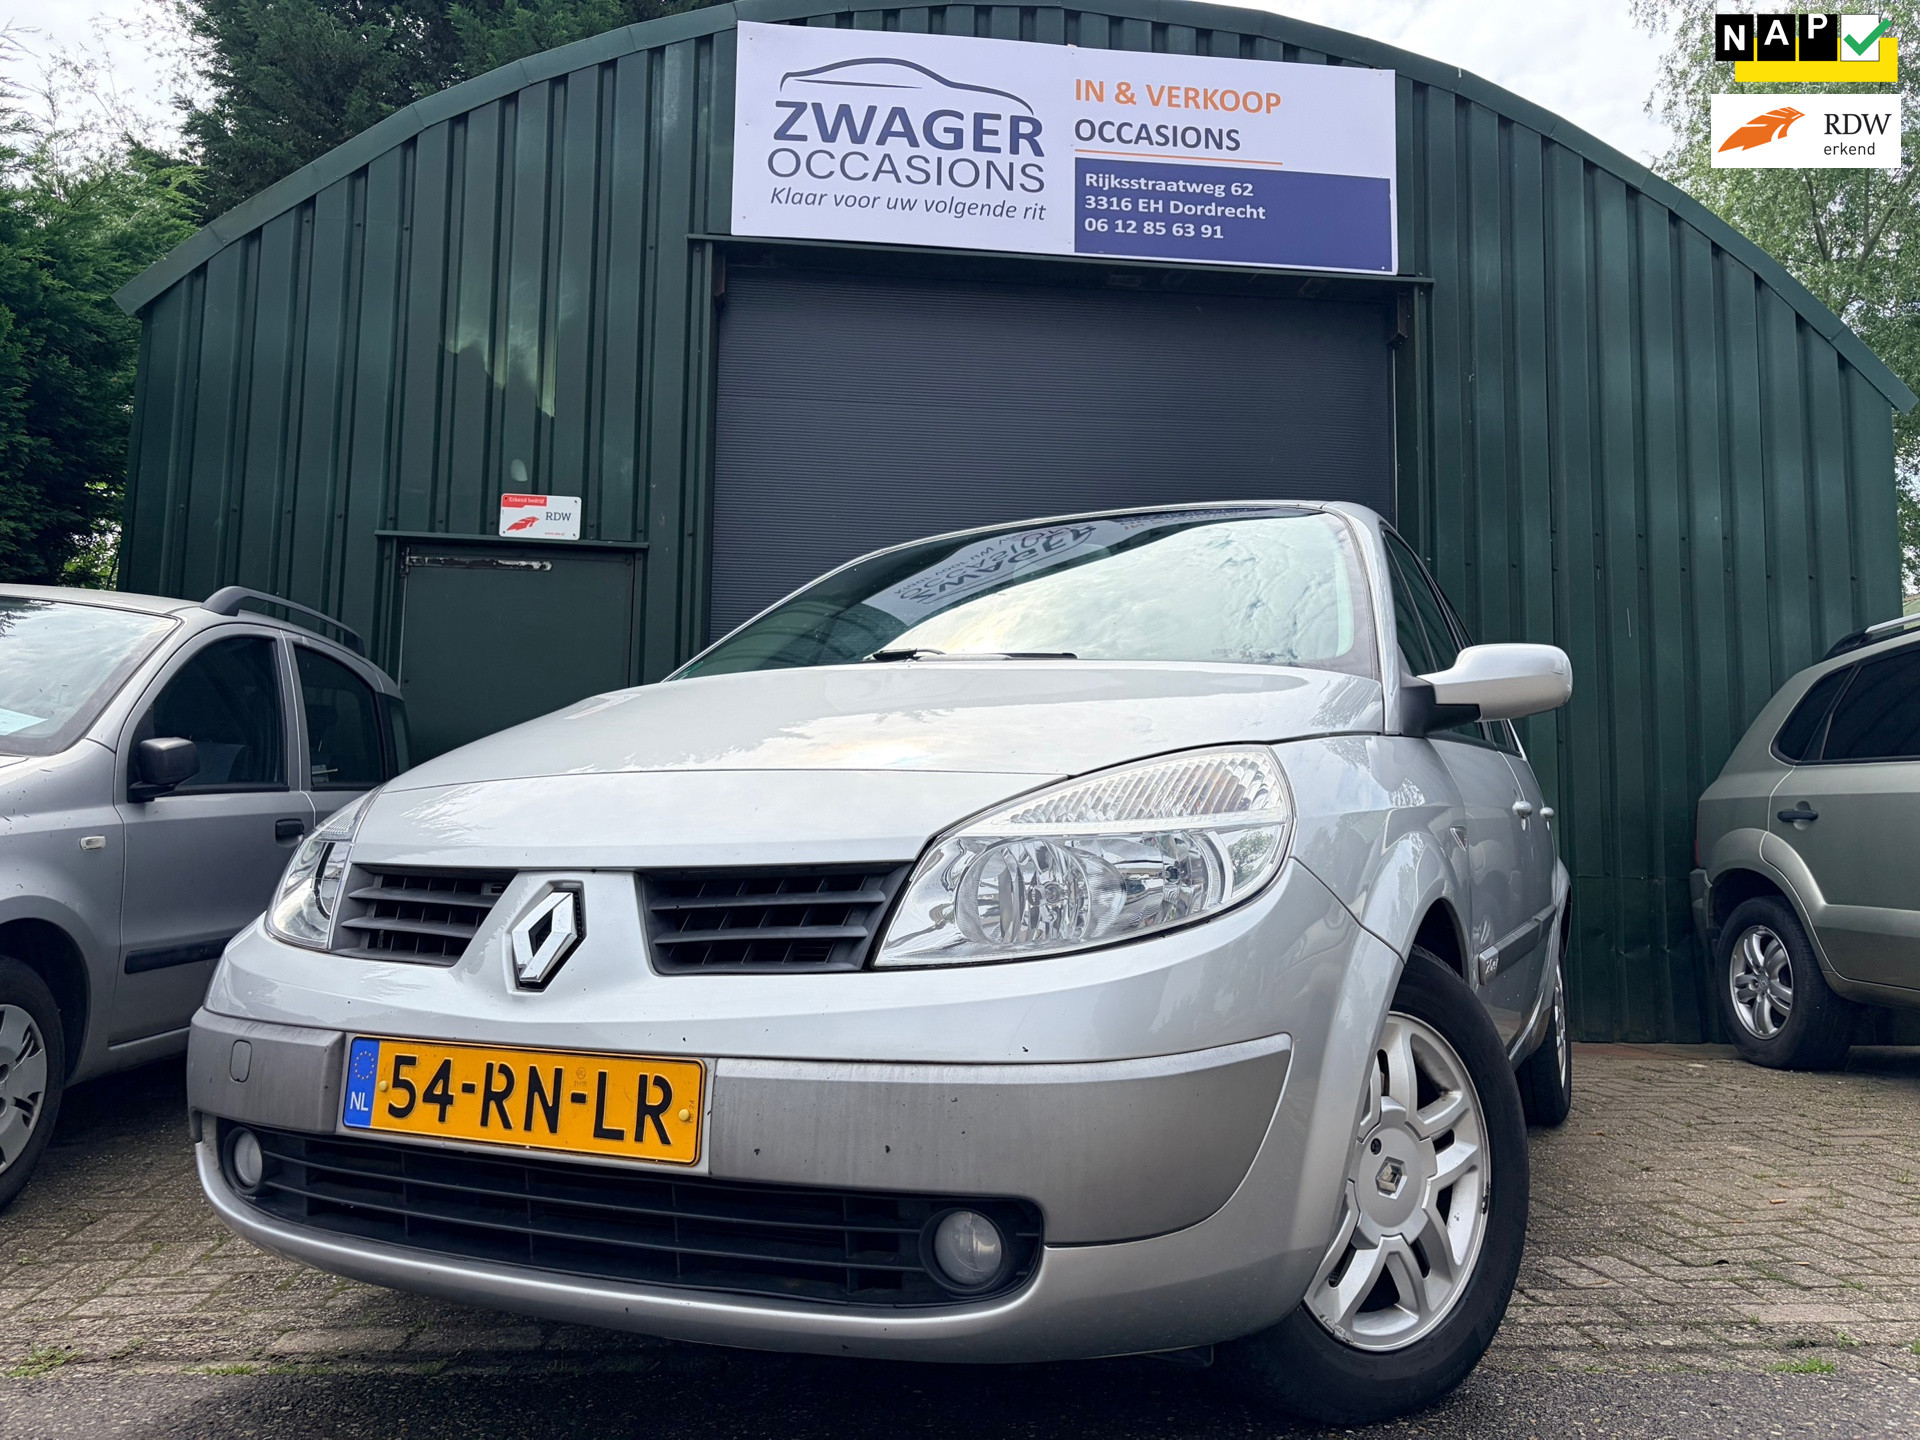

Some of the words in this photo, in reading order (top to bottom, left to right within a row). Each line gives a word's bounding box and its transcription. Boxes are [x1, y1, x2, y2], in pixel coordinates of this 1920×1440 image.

[1075, 79, 1104, 103] IN
[1114, 81, 1136, 105] &
[1146, 84, 1281, 114] VERKOOP
[773, 100, 1045, 157] ZWAGER
[1074, 118, 1241, 151] OCCASIONS
[767, 148, 1045, 193] OCCASIONS
[1085, 173, 1225, 197] Rijksstraatweg
[1231, 182, 1254, 196] 62
[770, 187, 827, 206] Klaar
[833, 193, 881, 209] voor
[886, 196, 918, 211] uw
[924, 197, 1017, 219] volgende
[1023, 203, 1047, 221] rit
[1085, 195, 1132, 211] 3316
[1138, 199, 1163, 213] EH
[1169, 200, 1266, 219] Dordrecht
[1084, 217, 1108, 232] 06
[1114, 220, 1137, 234] 12
[1143, 221, 1166, 235] 85
[1172, 223, 1195, 238] 63
[1201, 224, 1223, 239] 91
[545, 511, 572, 522] RDW
[350, 1091, 369, 1112] NL
[388, 1053, 672, 1146] 54-RN-LR
